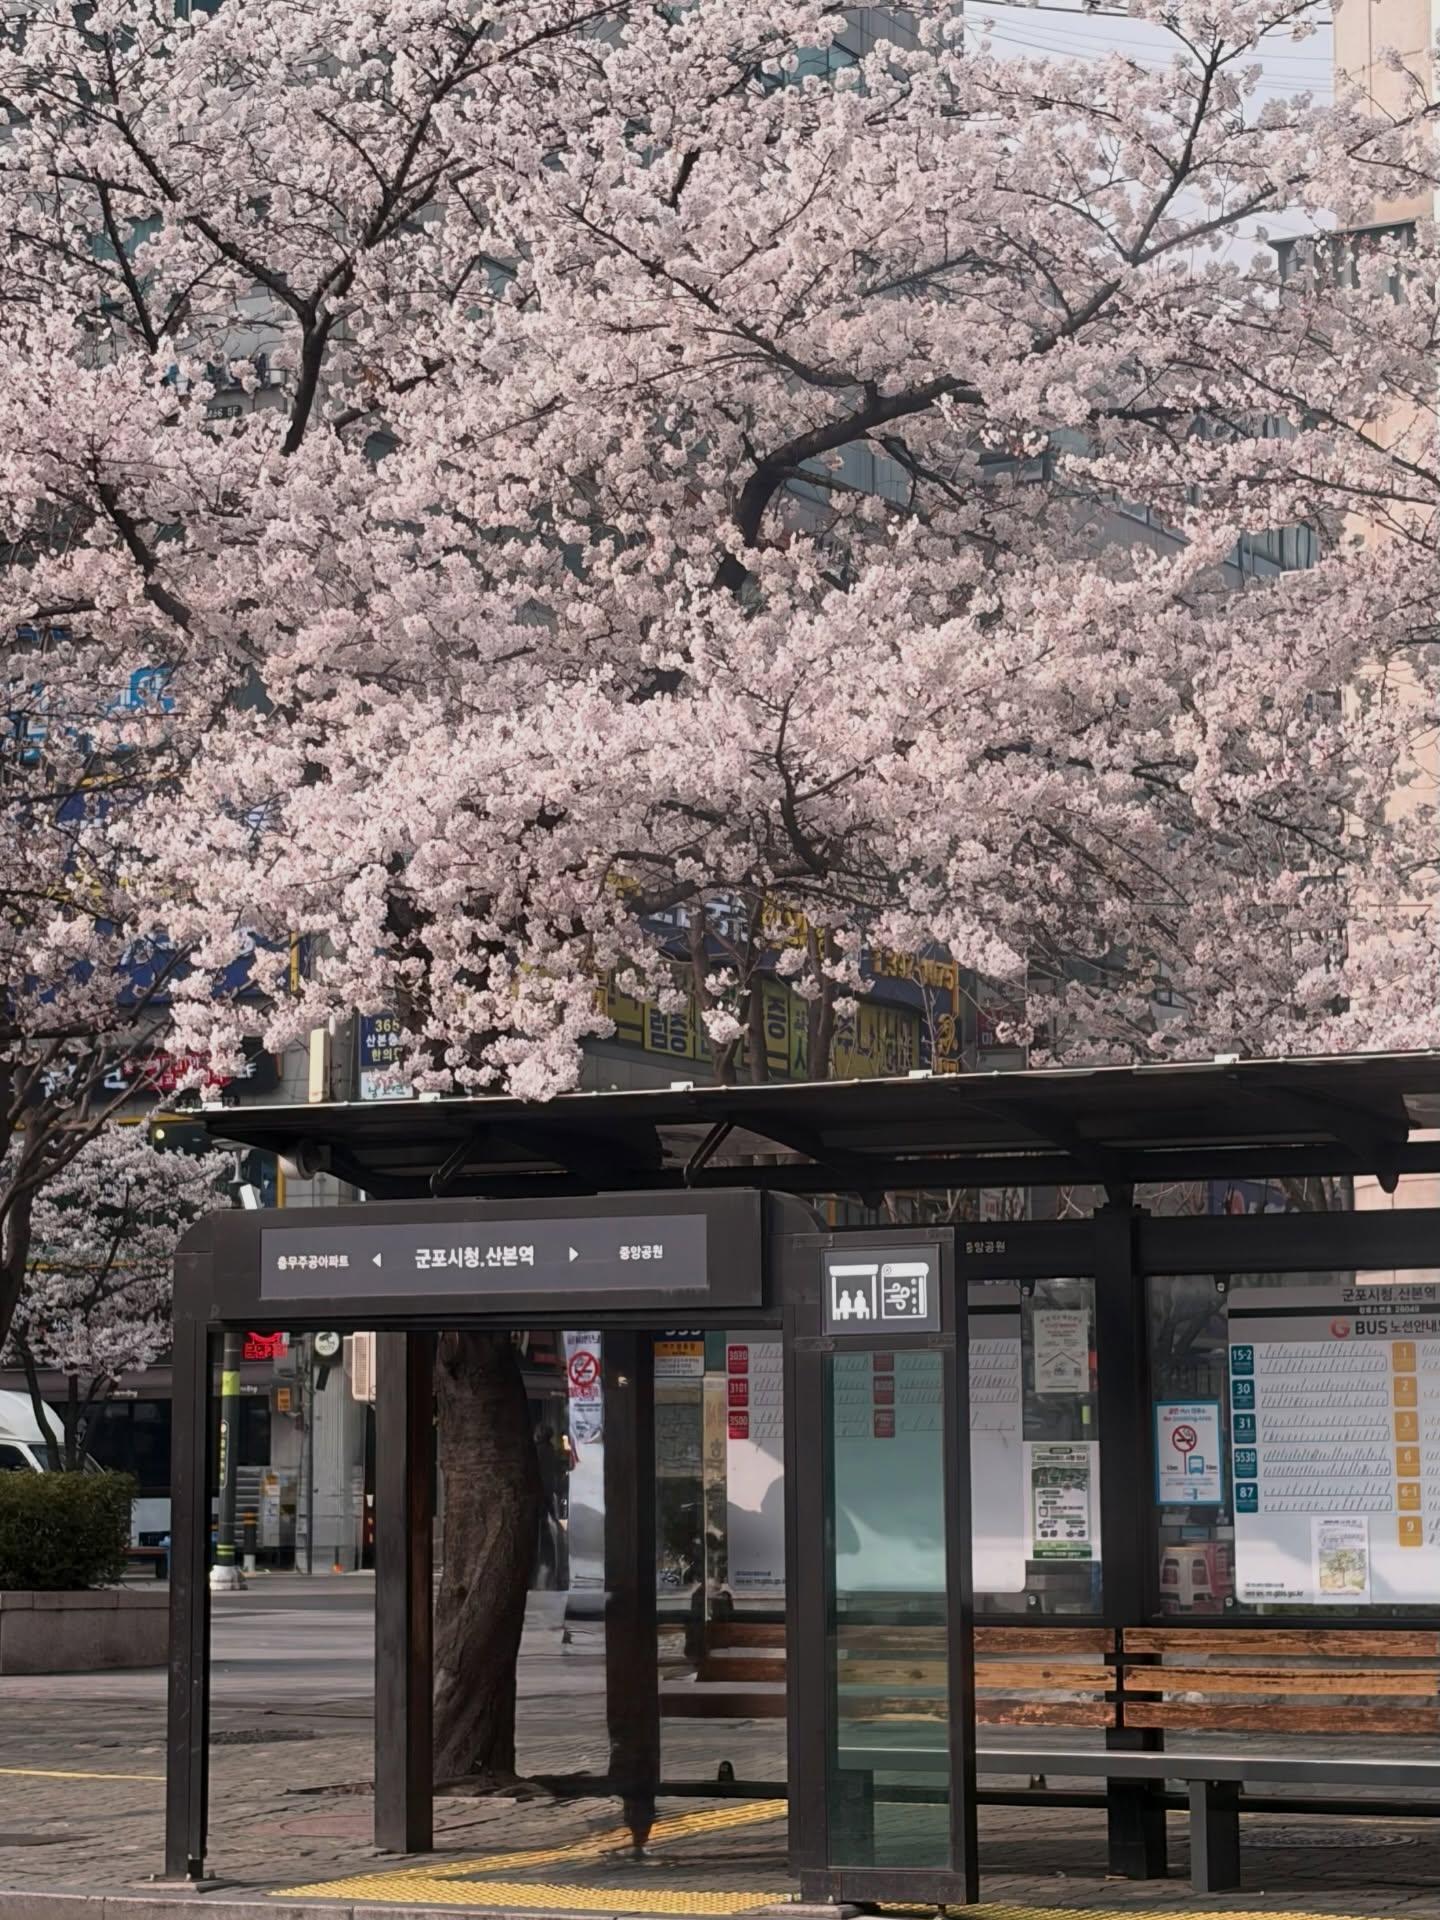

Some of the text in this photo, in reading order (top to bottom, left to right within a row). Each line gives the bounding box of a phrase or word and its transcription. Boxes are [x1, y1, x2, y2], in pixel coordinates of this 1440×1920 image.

[375, 1018, 400, 1033] 365
[619, 1244, 664, 1261] 중앙공원
[1355, 1320, 1388, 1336] BUS
[1390, 1319, 1440, 1335] 노선안내
[1232, 1349, 1253, 1361] 15-2
[1236, 1383, 1251, 1395] 30
[729, 1415, 748, 1426] 3500
[1239, 1418, 1251, 1429] 31
[1235, 1453, 1256, 1463] 5530
[1239, 1486, 1254, 1498] 87
[1406, 1521, 1415, 1532] 9
